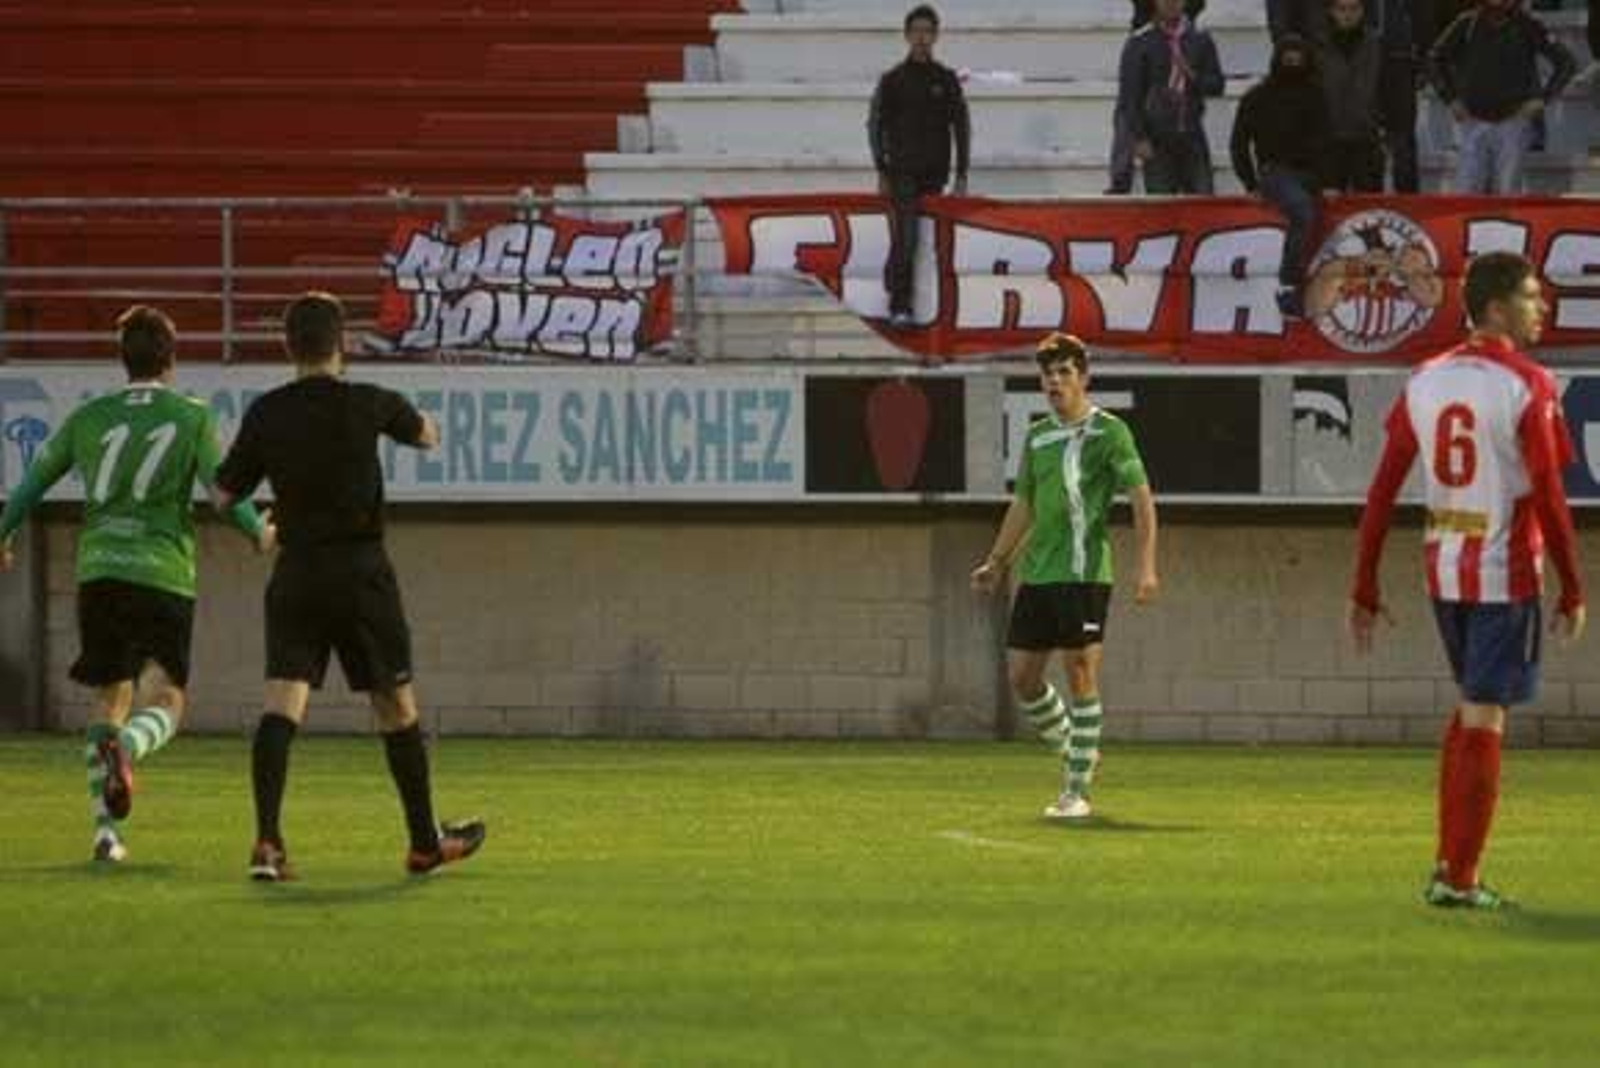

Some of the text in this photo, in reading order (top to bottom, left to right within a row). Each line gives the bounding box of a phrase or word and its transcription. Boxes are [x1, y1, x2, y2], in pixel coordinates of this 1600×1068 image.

[94, 421, 177, 506] 11
[557, 388, 793, 483] SANCHEZ
[1433, 403, 1477, 488] 6
